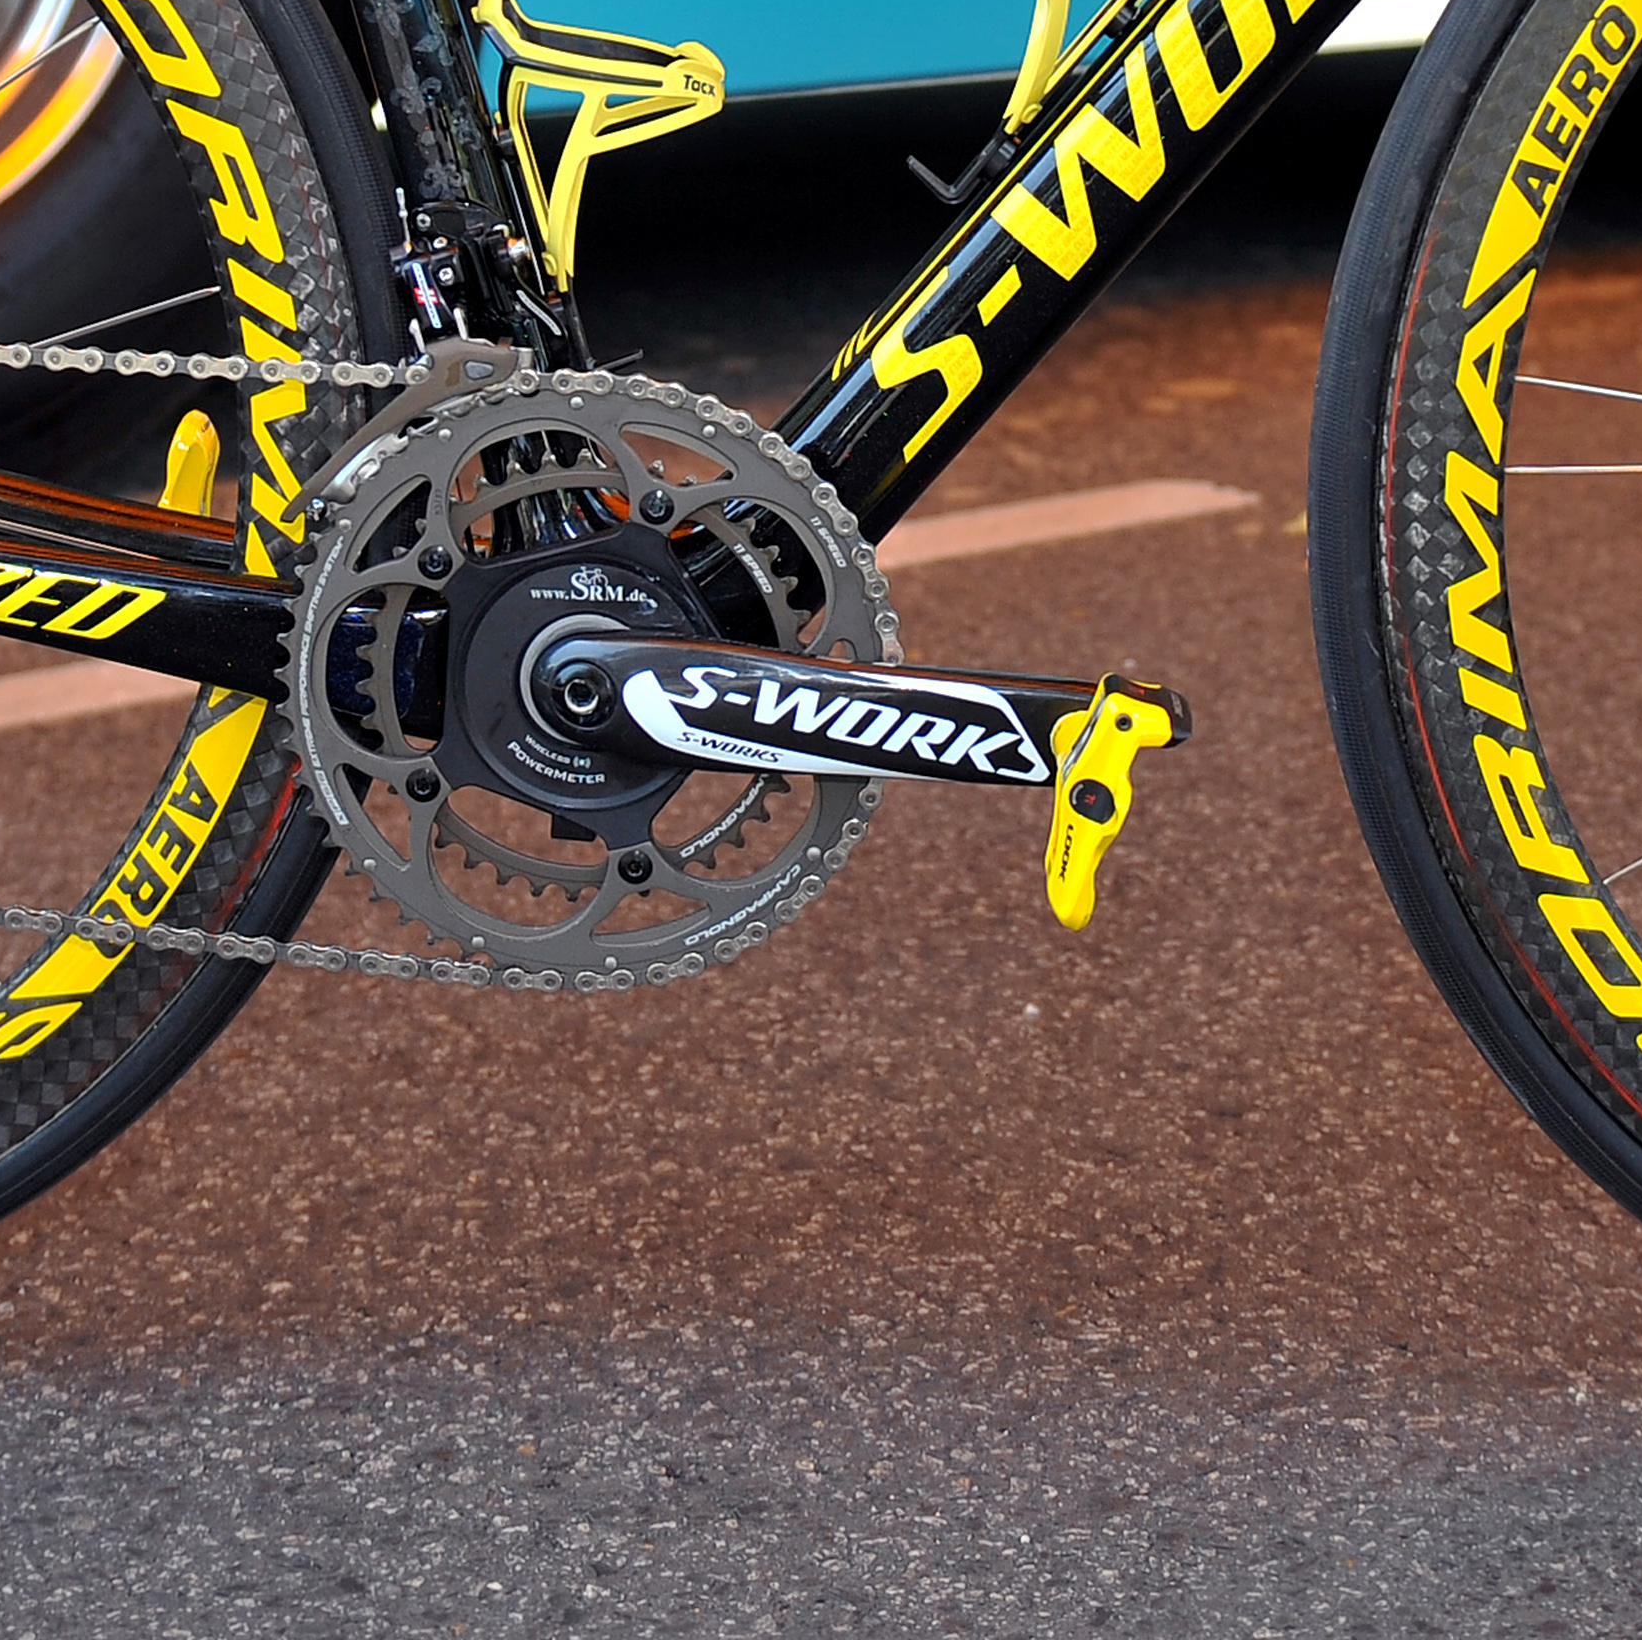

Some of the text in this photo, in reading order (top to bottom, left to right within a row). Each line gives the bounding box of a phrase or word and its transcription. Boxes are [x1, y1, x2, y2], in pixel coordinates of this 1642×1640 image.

[683, 73, 717, 97] Tacx
[1510, 3, 1638, 218] AERO
[676, 731, 784, 765] S-WORKS
[1059, 823, 1074, 883] LOOK
[683, 863, 802, 947] CAMPAGNOLO
